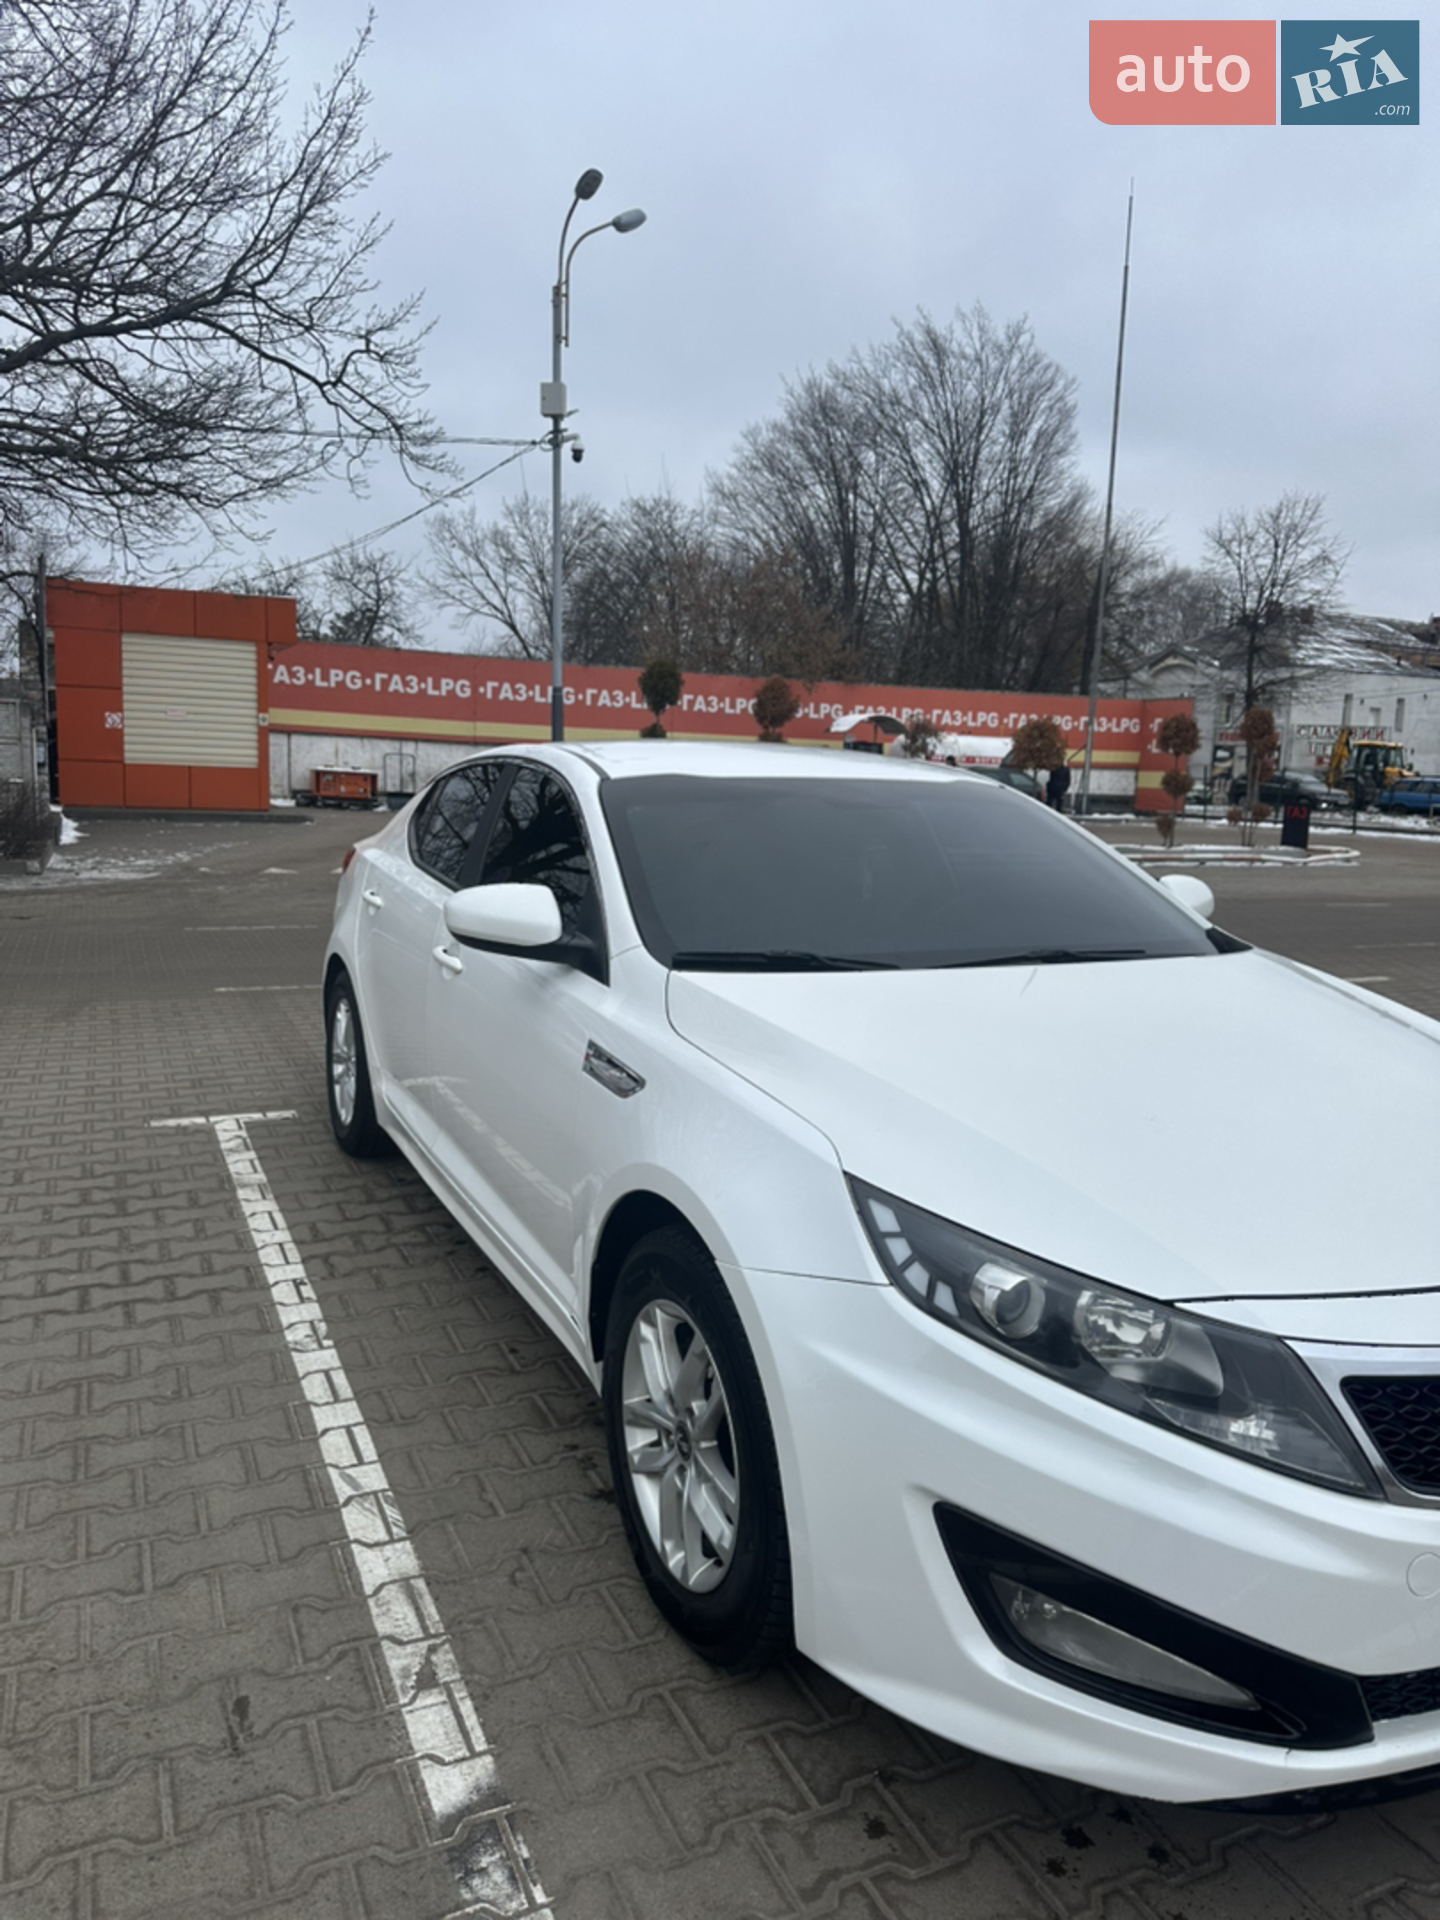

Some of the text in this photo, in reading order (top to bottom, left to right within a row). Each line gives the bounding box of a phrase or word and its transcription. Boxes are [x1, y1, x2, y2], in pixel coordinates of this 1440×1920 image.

[267, 664, 307, 685] АЗ
[313, 667, 362, 690] LPG
[373, 672, 419, 694] ГАЗ
[426, 676, 472, 698] LPG
[485, 681, 528, 701] ГАЗ
[585, 688, 625, 709] ГАЗ
[681, 694, 720, 713] ГАЗ
[930, 708, 963, 727] ГАЗ
[966, 711, 999, 729] LPG
